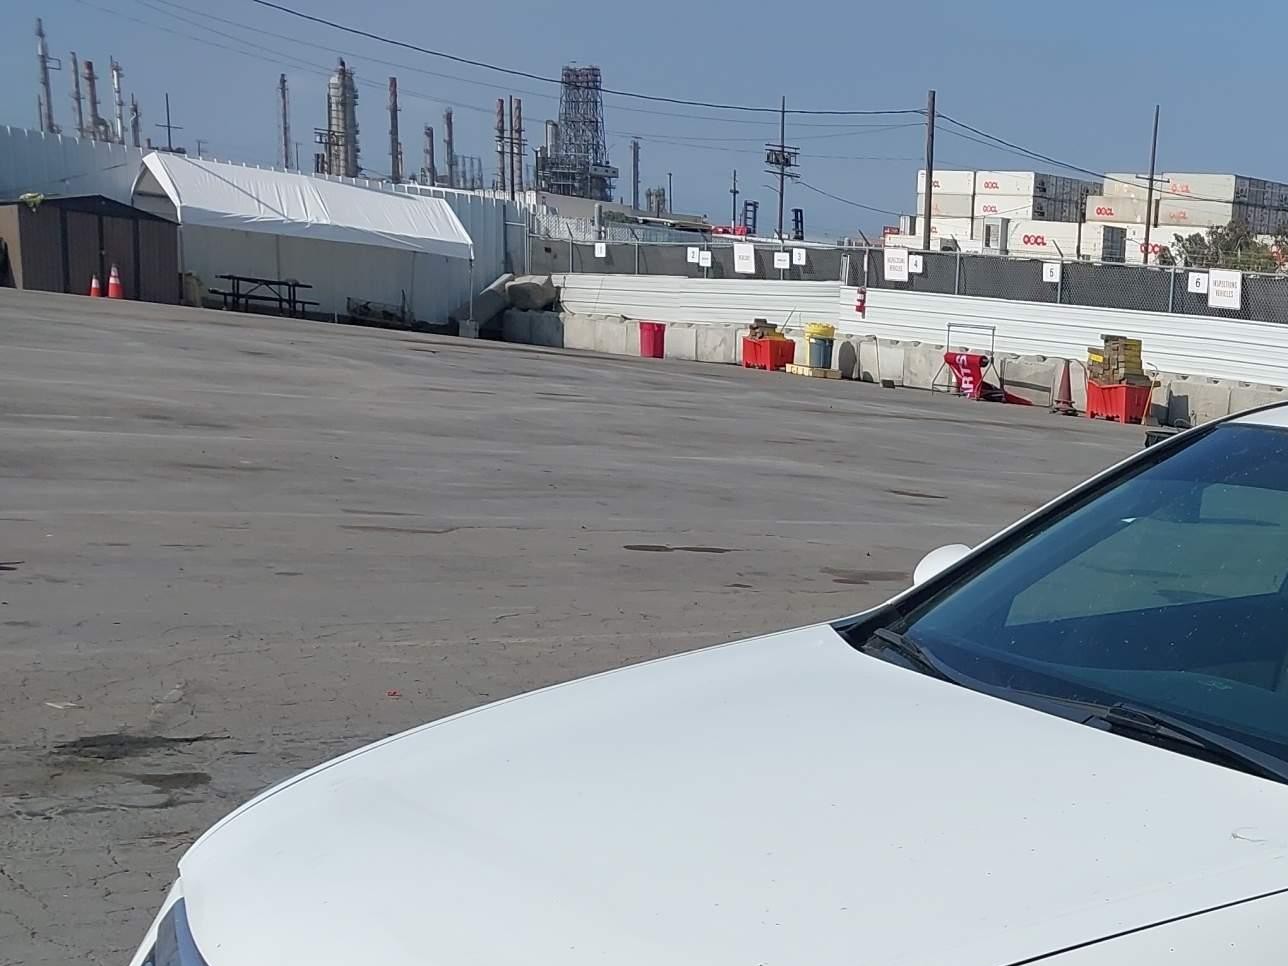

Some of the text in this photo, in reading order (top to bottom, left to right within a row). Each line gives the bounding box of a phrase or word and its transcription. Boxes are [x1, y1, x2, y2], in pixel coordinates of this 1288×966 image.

[1023, 234, 1047, 246] OOCL
[914, 259, 919, 269] 4
[1195, 277, 1201, 288] 6
